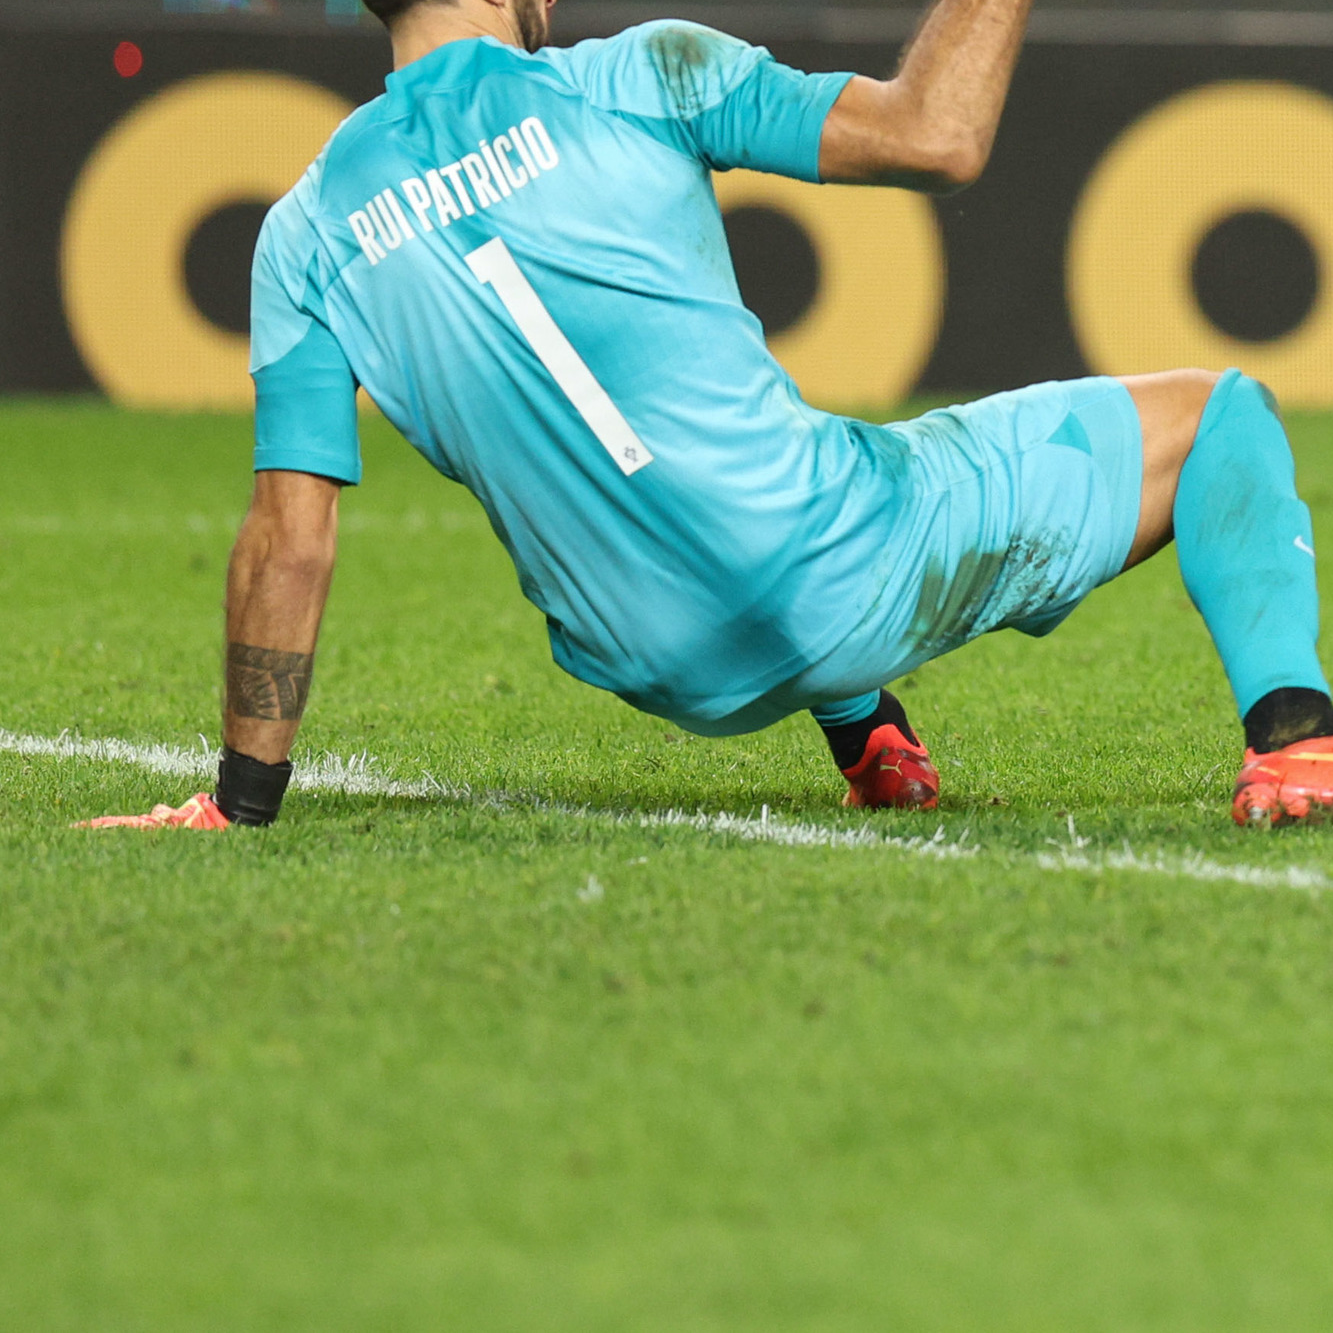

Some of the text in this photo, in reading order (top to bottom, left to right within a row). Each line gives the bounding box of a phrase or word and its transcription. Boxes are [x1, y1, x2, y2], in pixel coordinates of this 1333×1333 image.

[347, 116, 560, 266] RUI PATRÍCIO
[464, 236, 655, 477] 1
